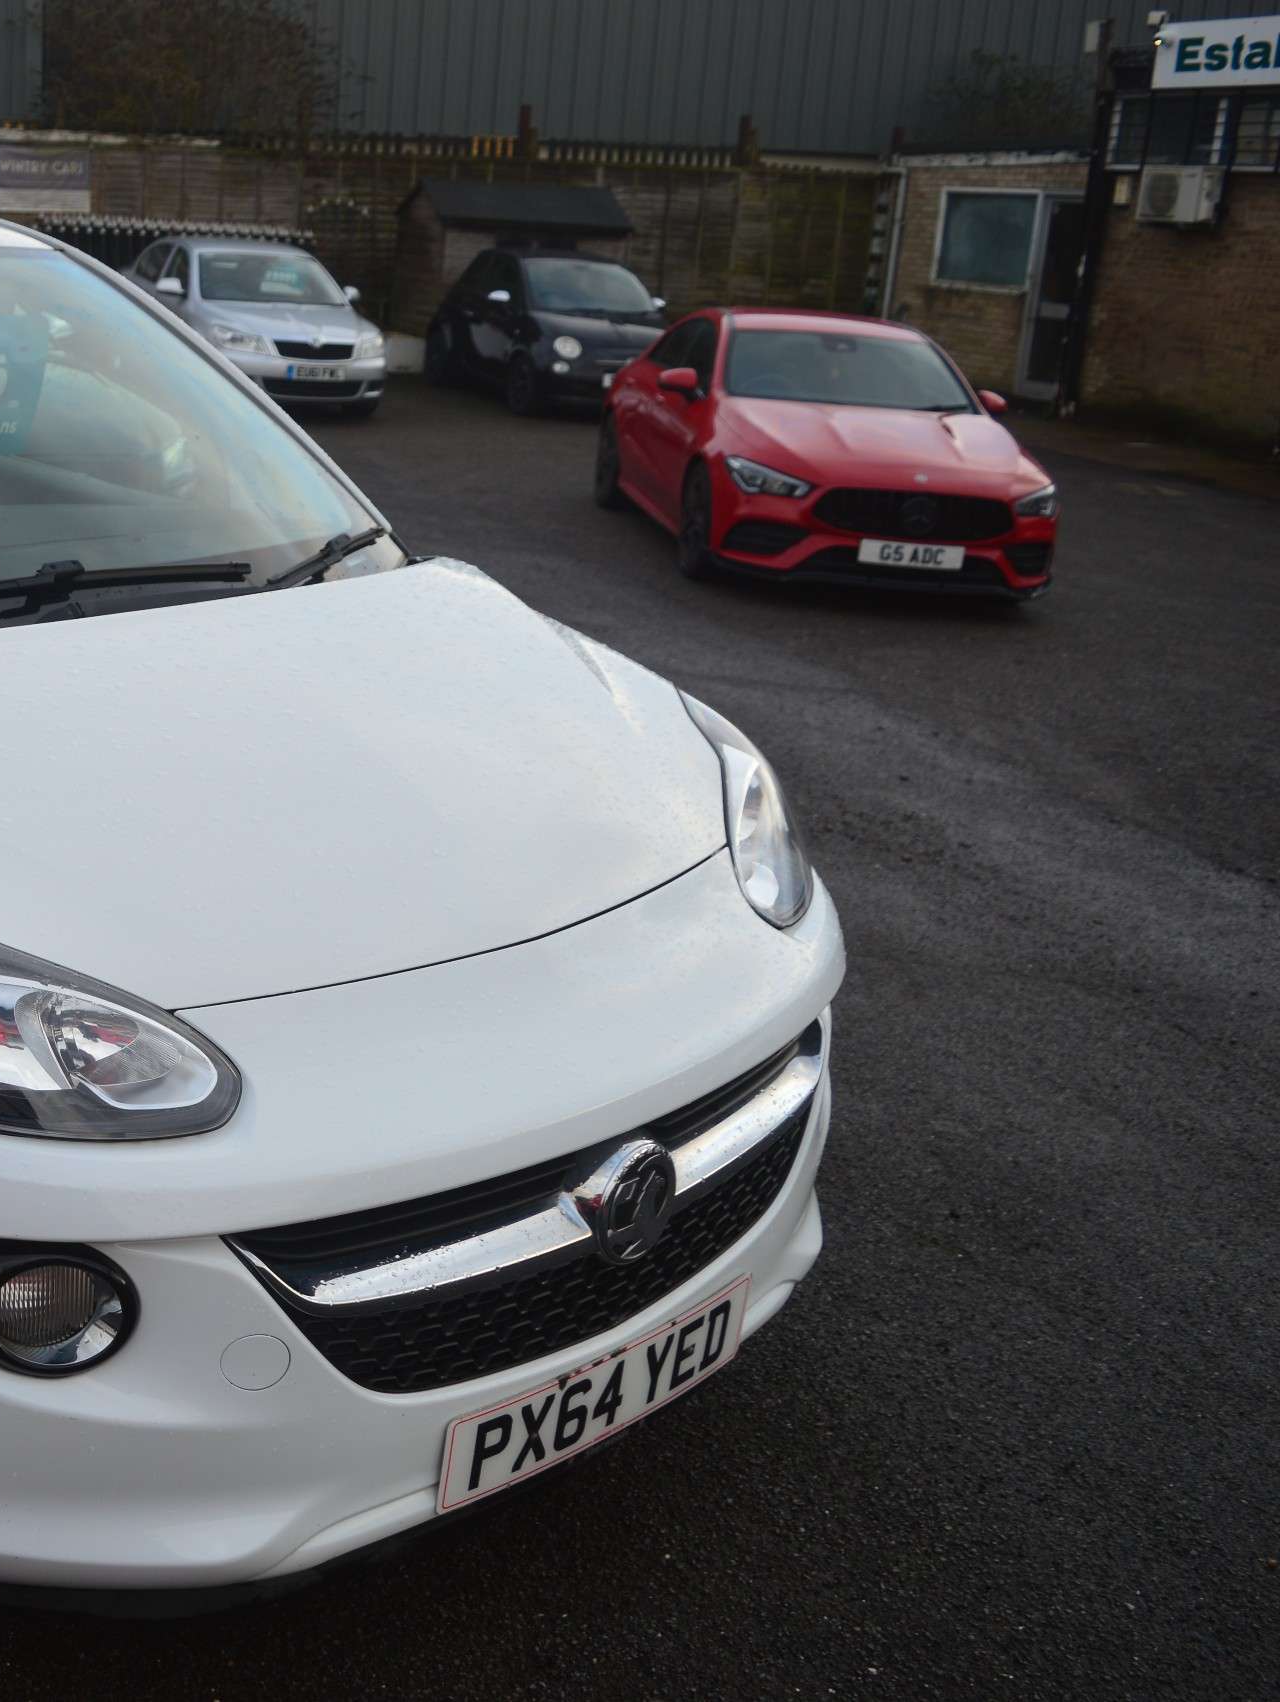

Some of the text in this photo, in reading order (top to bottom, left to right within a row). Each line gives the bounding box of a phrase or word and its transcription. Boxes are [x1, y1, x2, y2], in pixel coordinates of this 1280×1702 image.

[51, 159, 84, 176] CARS
[909, 546, 946, 565] ADC
[468, 1299, 731, 1491] PX64 YED
